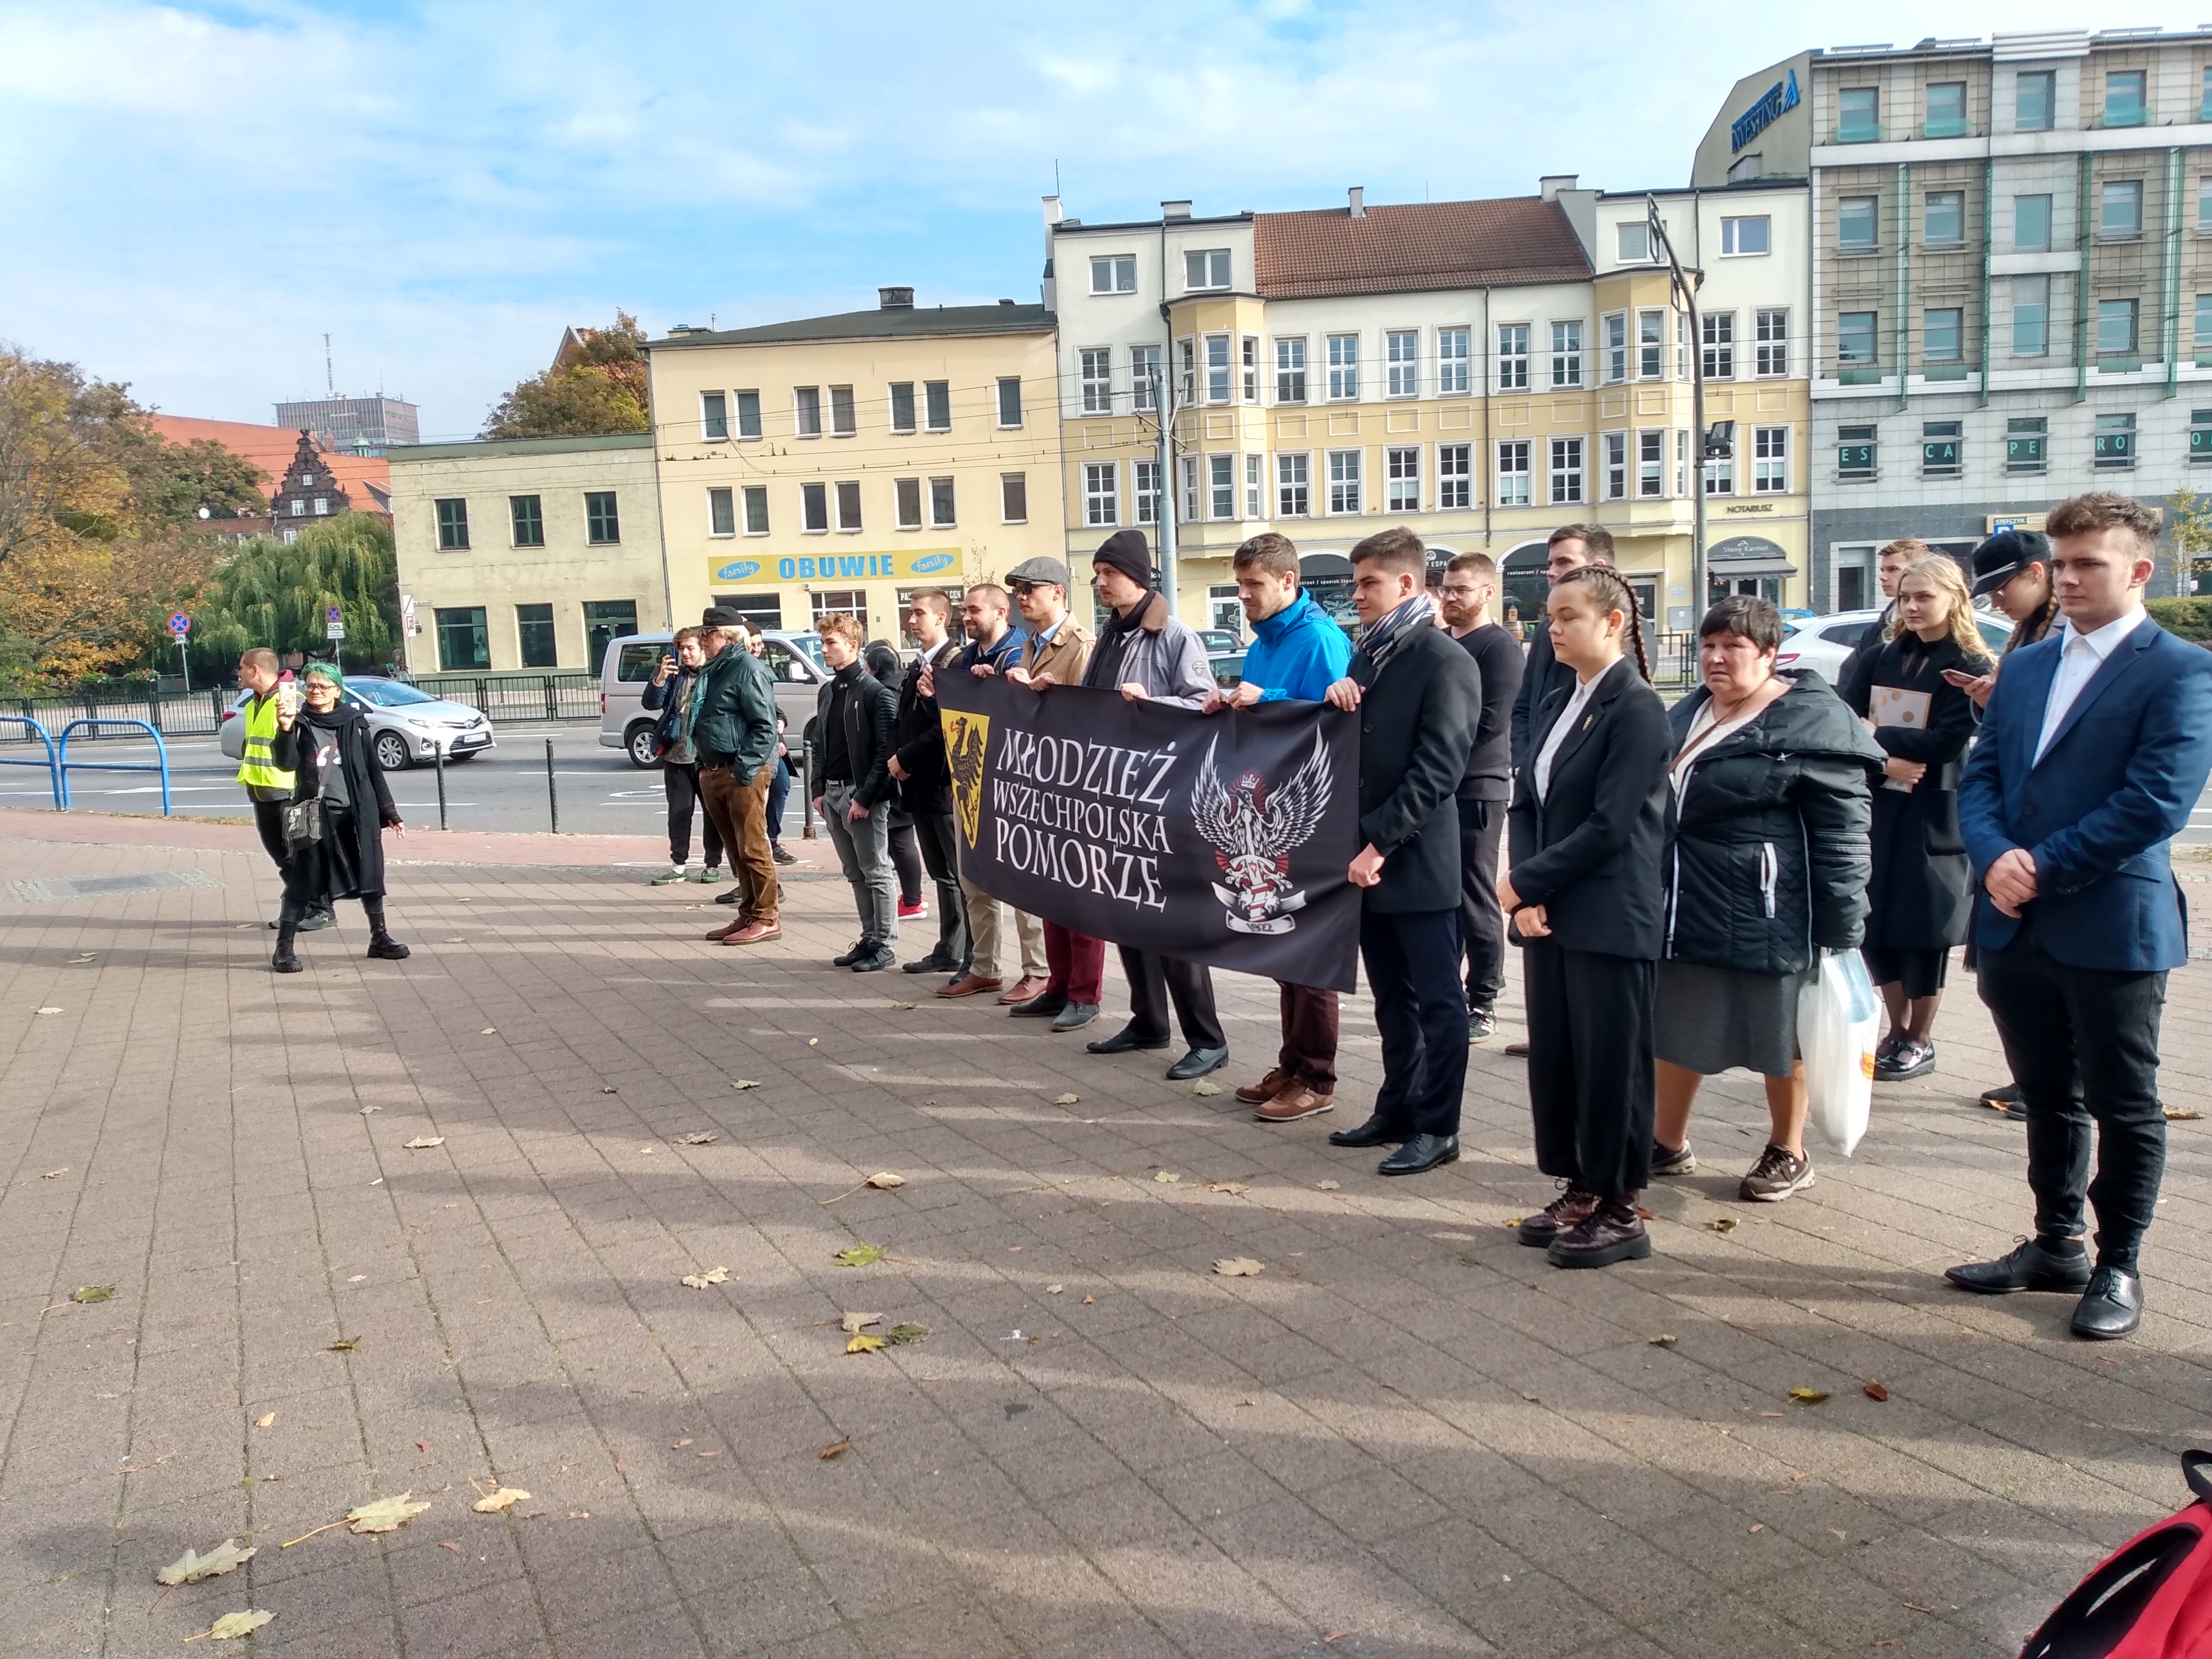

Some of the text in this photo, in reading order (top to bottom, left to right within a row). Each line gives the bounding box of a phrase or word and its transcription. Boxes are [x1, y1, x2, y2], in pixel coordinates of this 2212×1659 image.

[1727, 504, 1773, 514] NOTARIUSZ
[723, 562, 755, 579] family
[778, 555, 894, 580] OBUWIE
[916, 555, 949, 573] family
[949, 590, 961, 599] CEN
[995, 728, 1178, 812] MŁODZIEŻ
[993, 777, 1174, 854] WSZECHPOLSKA
[995, 817, 1168, 913] POMORZE
[1246, 923, 1275, 932] 1922
